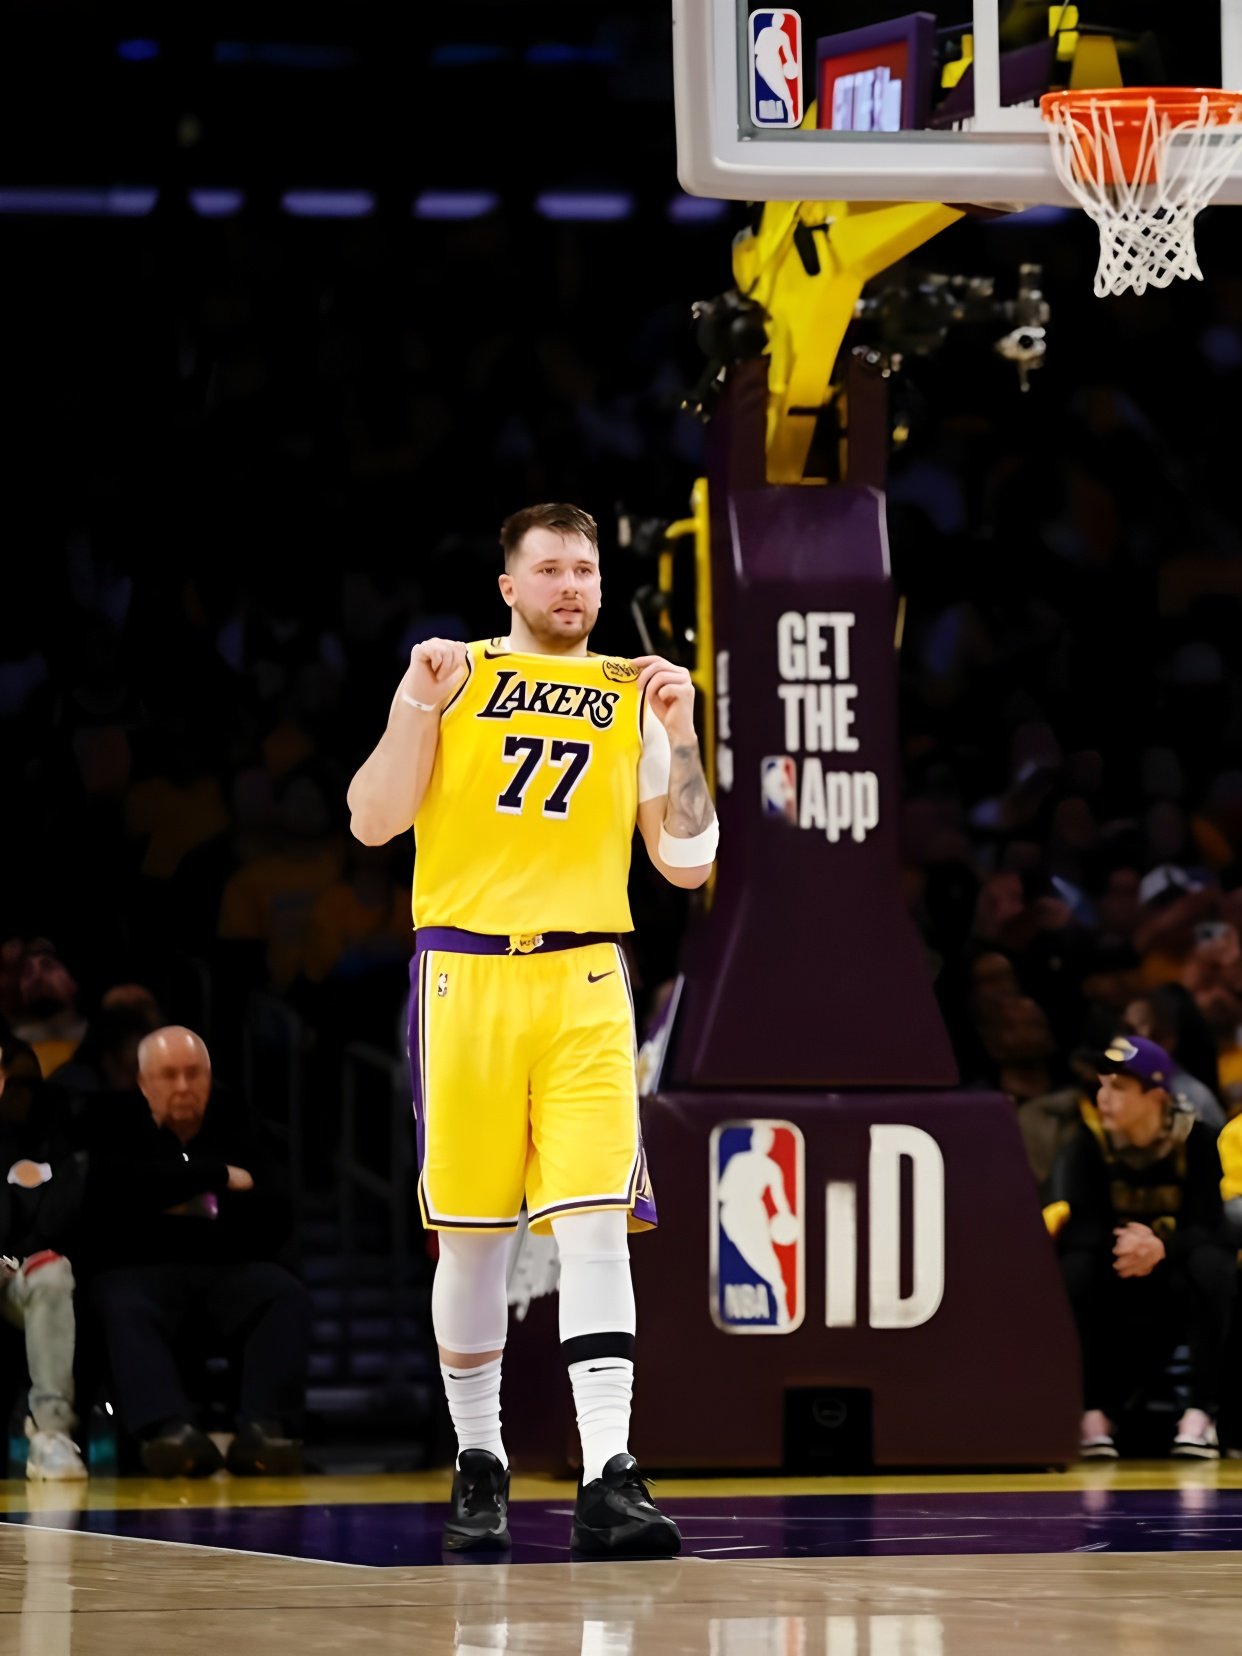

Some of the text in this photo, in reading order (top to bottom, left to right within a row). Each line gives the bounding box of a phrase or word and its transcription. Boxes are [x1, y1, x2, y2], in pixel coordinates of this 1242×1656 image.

[777, 611, 856, 681] GET
[475, 670, 621, 731] LAKERS
[777, 684, 860, 752] THE
[497, 735, 592, 818] 77
[800, 757, 879, 843] App
